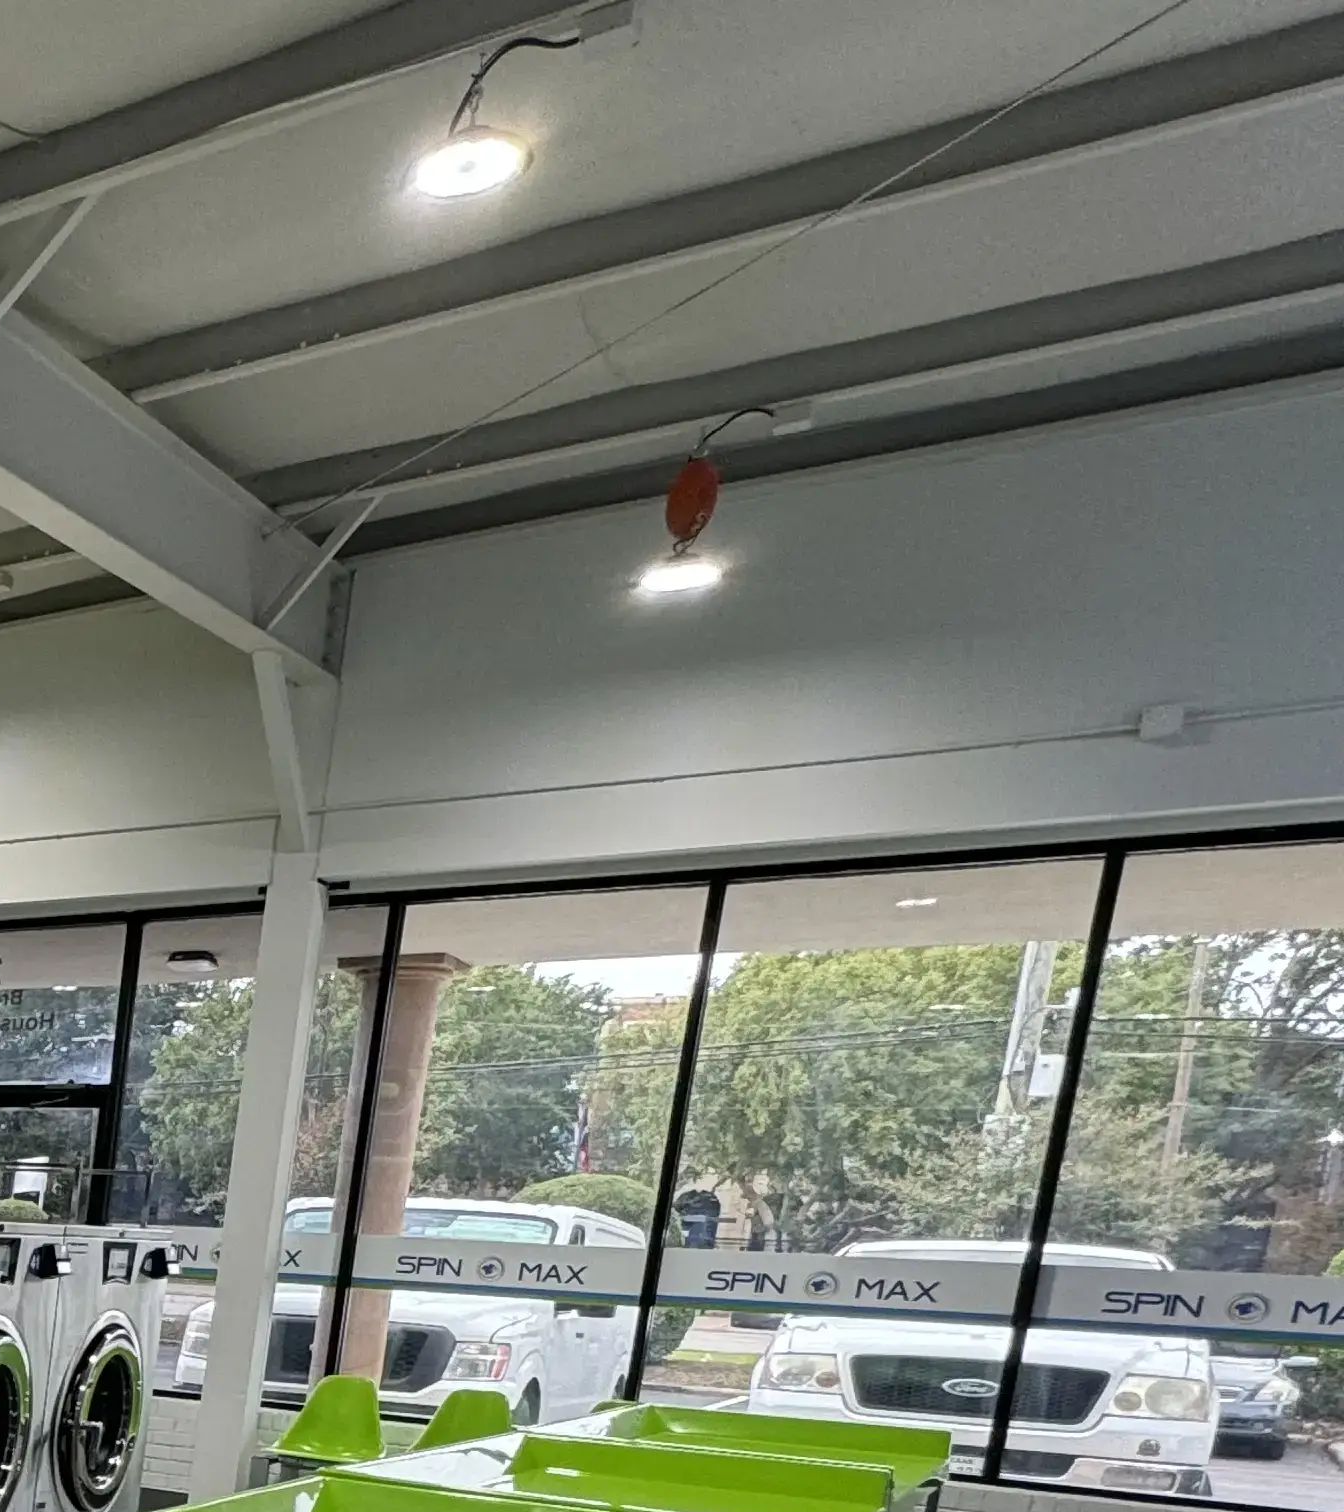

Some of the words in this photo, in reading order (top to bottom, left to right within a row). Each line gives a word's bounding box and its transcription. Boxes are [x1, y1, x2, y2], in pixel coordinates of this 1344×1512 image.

[395, 1255, 463, 1277] SPIN
[517, 1262, 589, 1286] MAX
[705, 1270, 788, 1295] SPIN
[854, 1277, 941, 1304] MAX
[1100, 1291, 1205, 1318] SPIN
